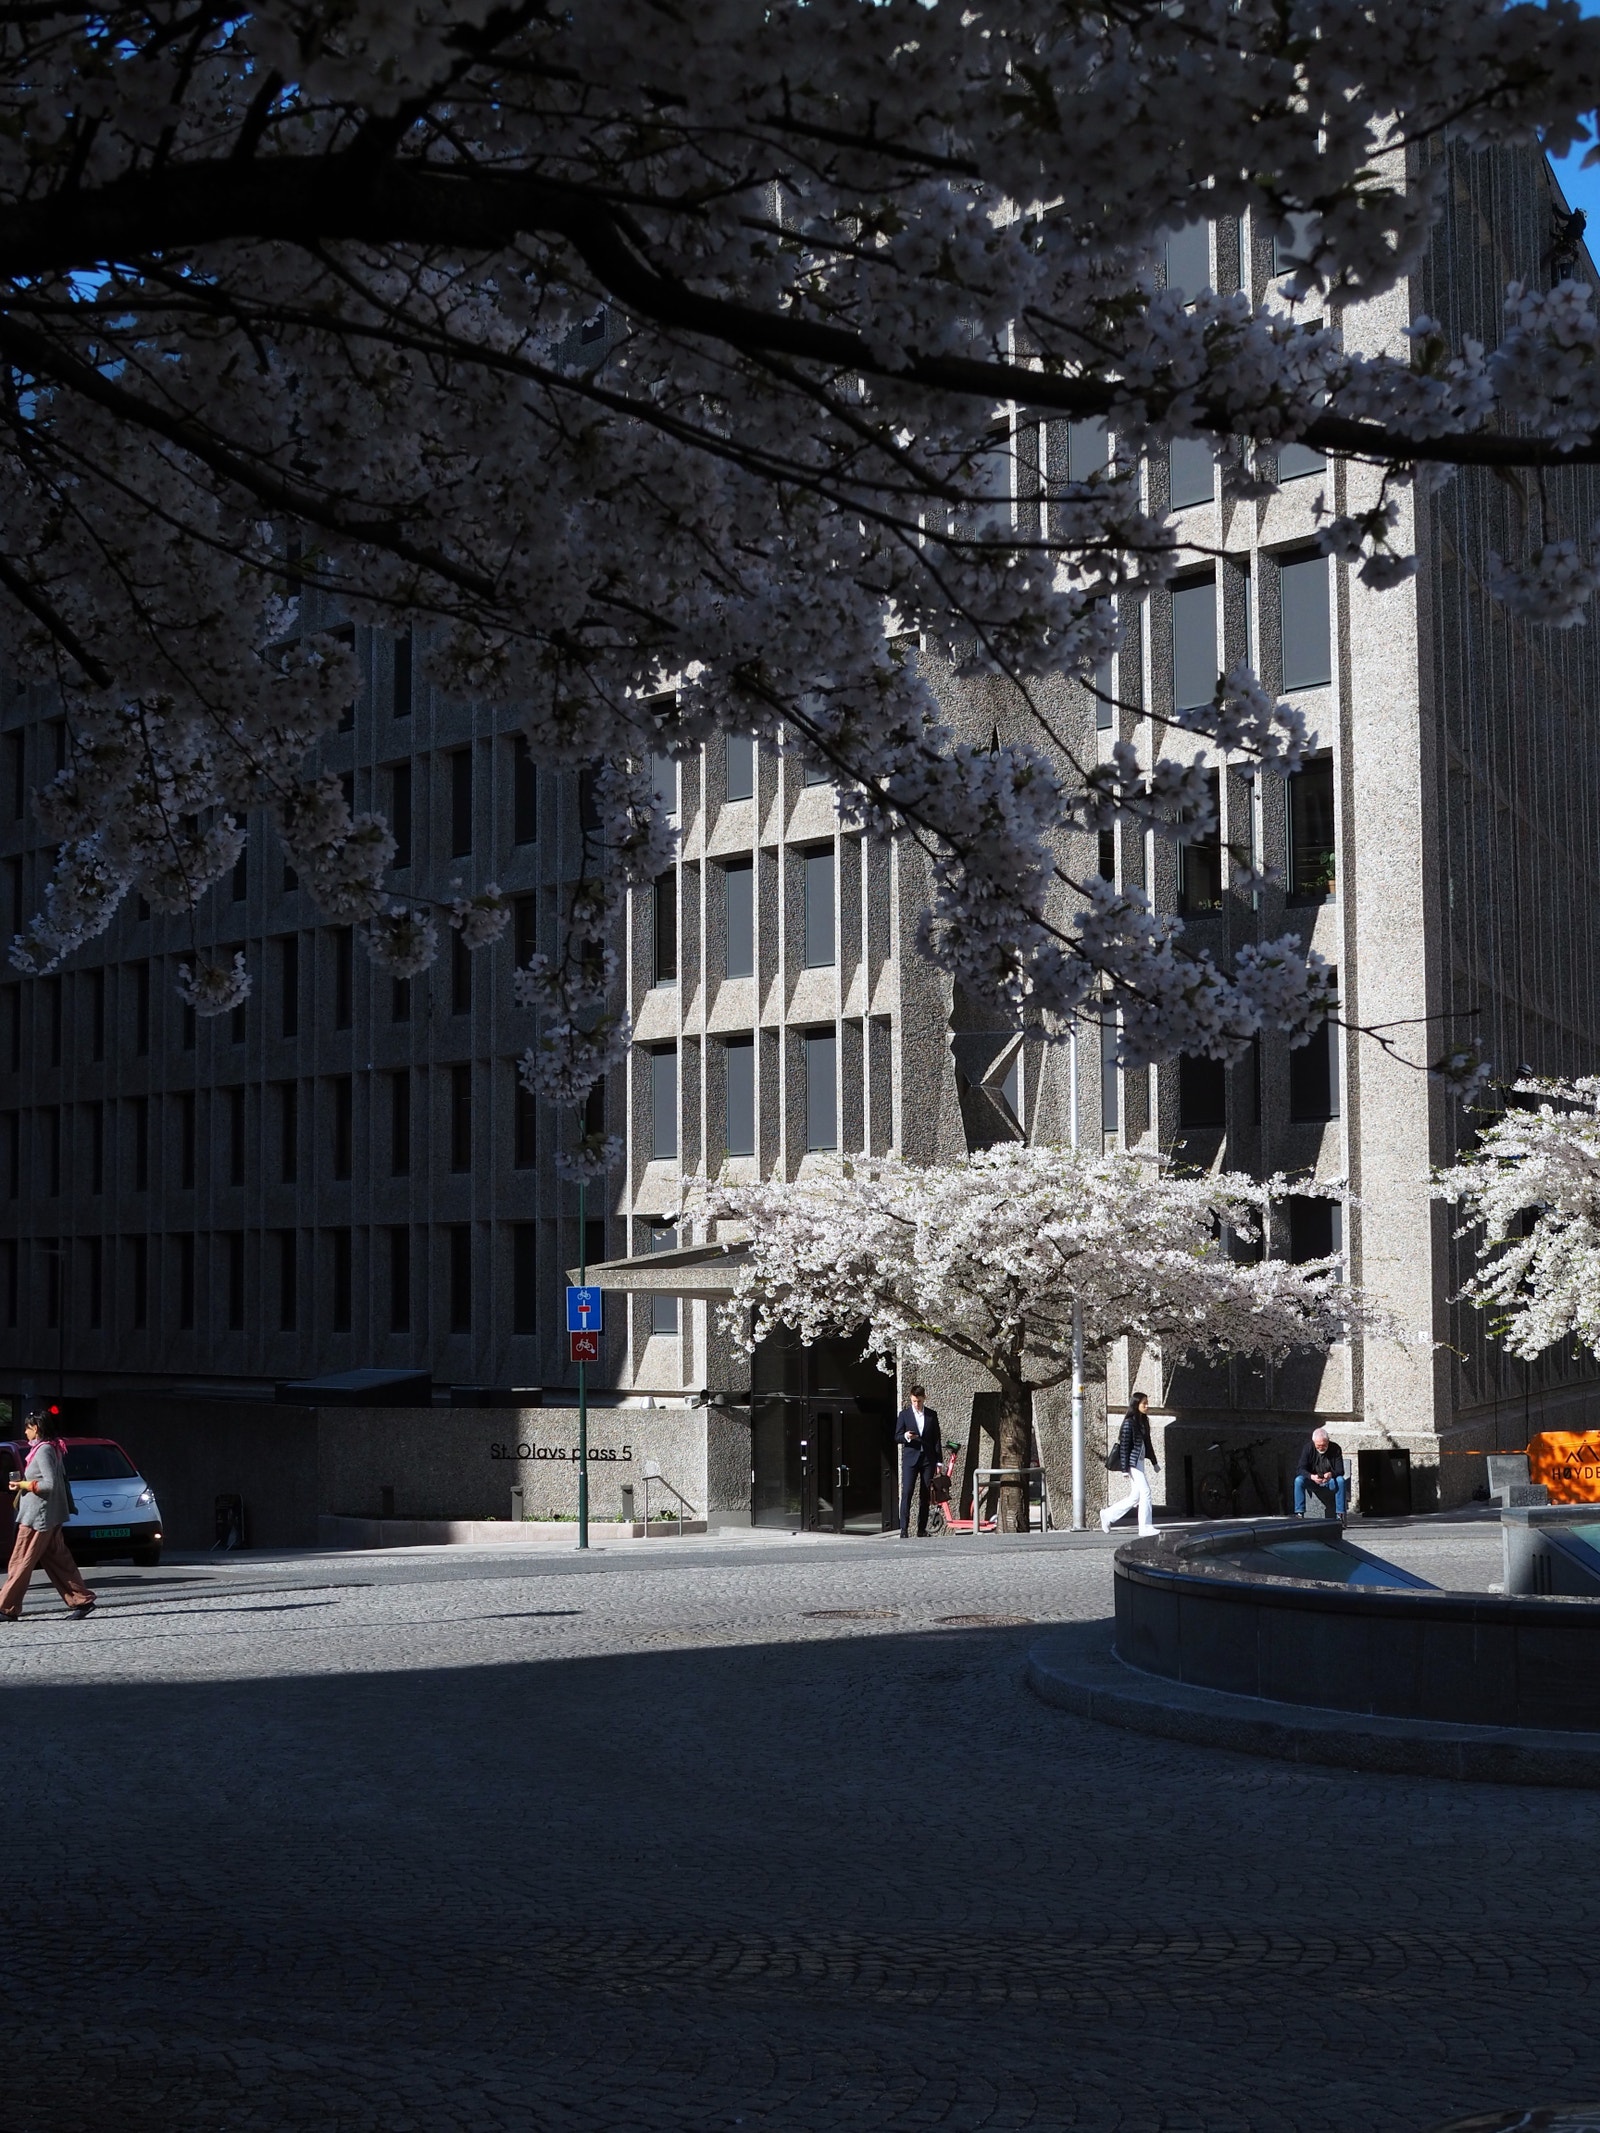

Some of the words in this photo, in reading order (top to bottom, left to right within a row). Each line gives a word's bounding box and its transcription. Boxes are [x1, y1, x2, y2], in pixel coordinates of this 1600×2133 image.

[491, 1443, 511, 1459] St.
[517, 1443, 566, 1459] Olavs
[572, 1446, 616, 1463] pass
[622, 1445, 632, 1460] 5
